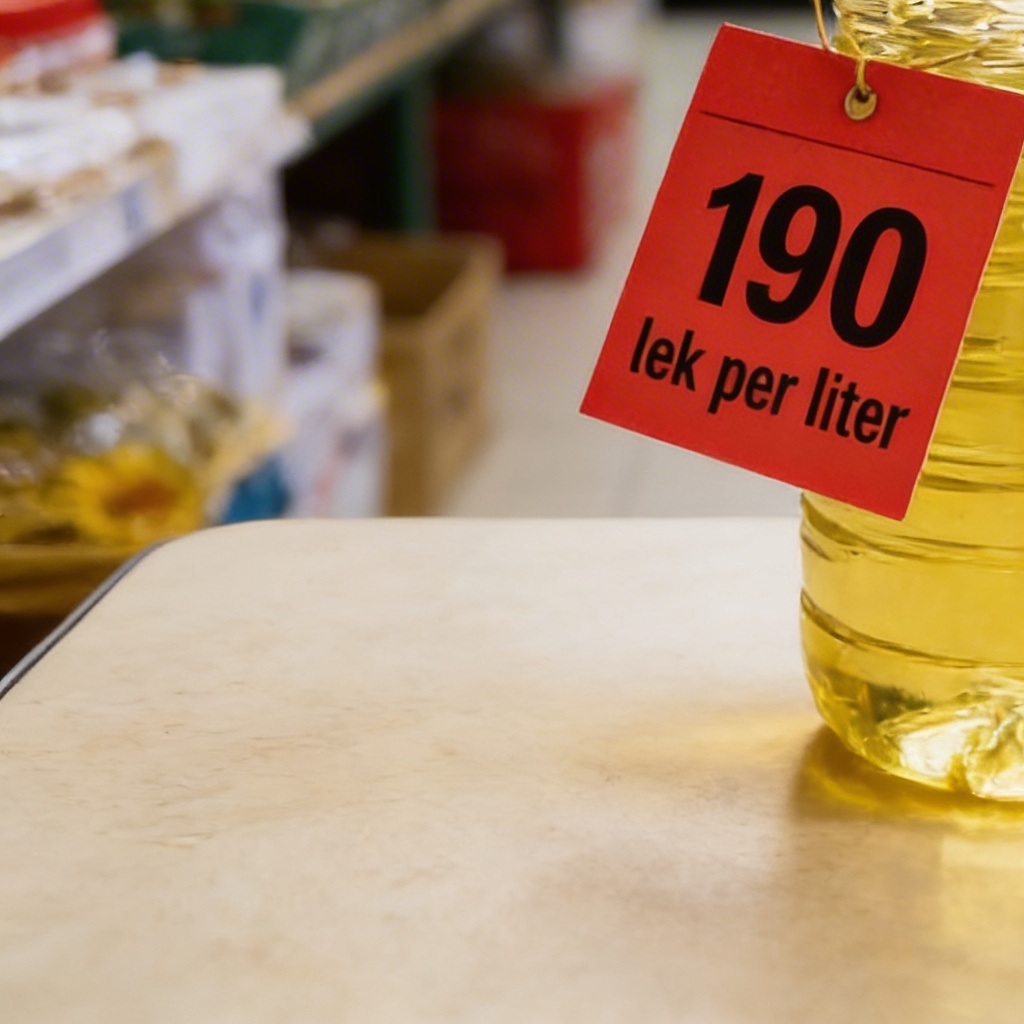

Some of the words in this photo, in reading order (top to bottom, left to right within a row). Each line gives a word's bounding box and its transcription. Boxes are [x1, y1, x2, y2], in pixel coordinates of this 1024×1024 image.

[697, 172, 928, 349] 190
[629, 316, 706, 393] lek
[707, 355, 800, 416] per
[804, 367, 911, 451] liter
